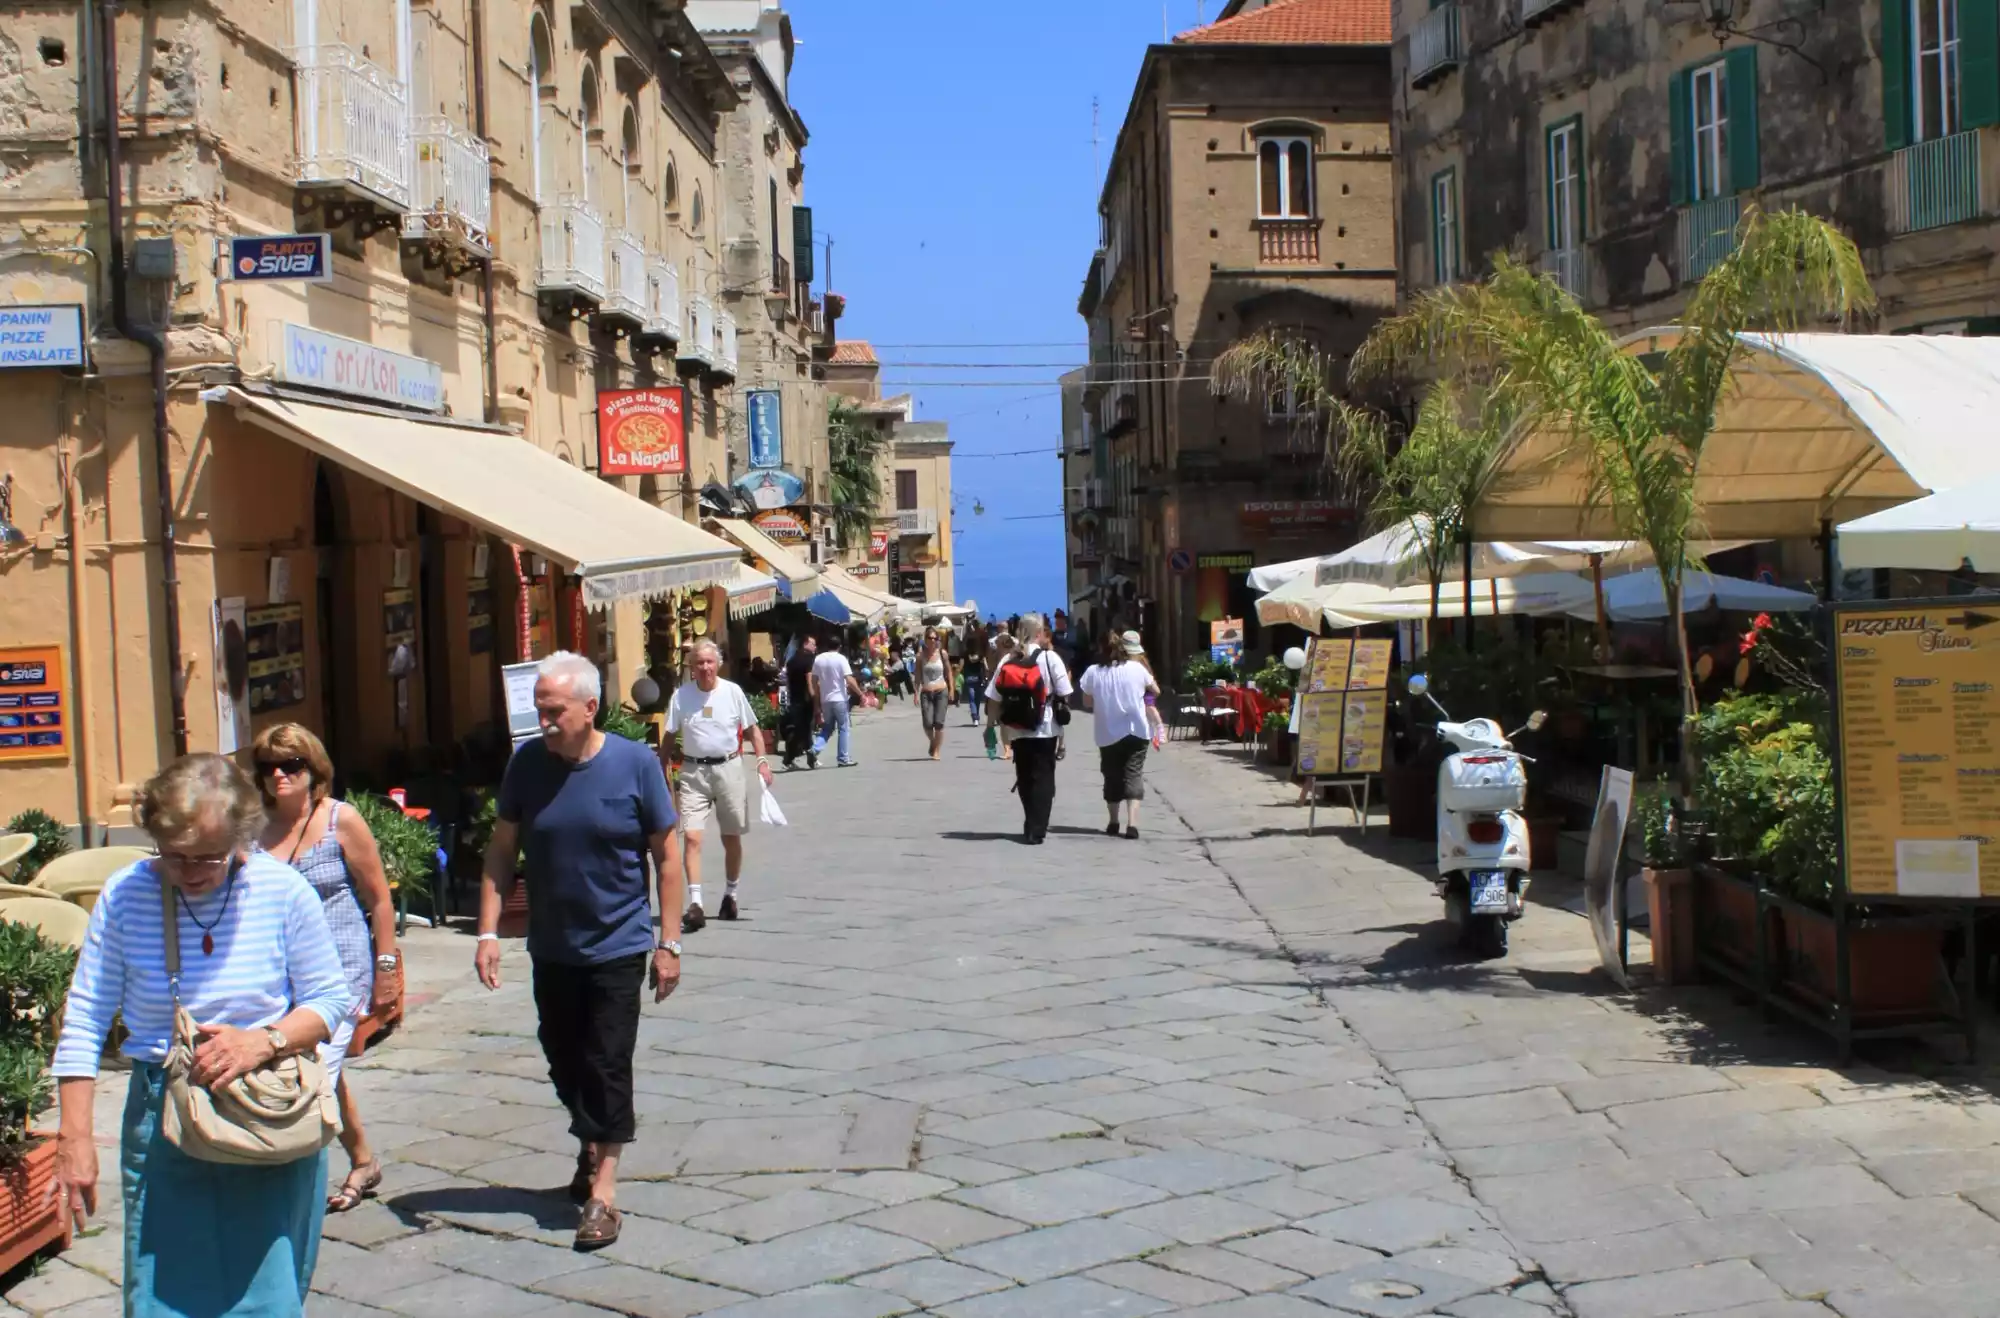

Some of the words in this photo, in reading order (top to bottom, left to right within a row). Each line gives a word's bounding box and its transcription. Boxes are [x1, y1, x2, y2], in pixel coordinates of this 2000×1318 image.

[0, 311, 52, 325] PANINI
[1, 331, 46, 344] PIZZE
[2, 348, 77, 361] INSALATE
[605, 395, 634, 416] pizza
[635, 391, 647, 402] al
[649, 392, 680, 414] taglio
[608, 446, 628, 465] La
[630, 443, 680, 468] Napoli
[1244, 500, 1296, 512] ISOLE
[764, 529, 802, 538] ATTORIA
[871, 535, 886, 553] illy
[847, 566, 879, 575] MARTINI
[1841, 615, 1927, 636] PIZZERIA
